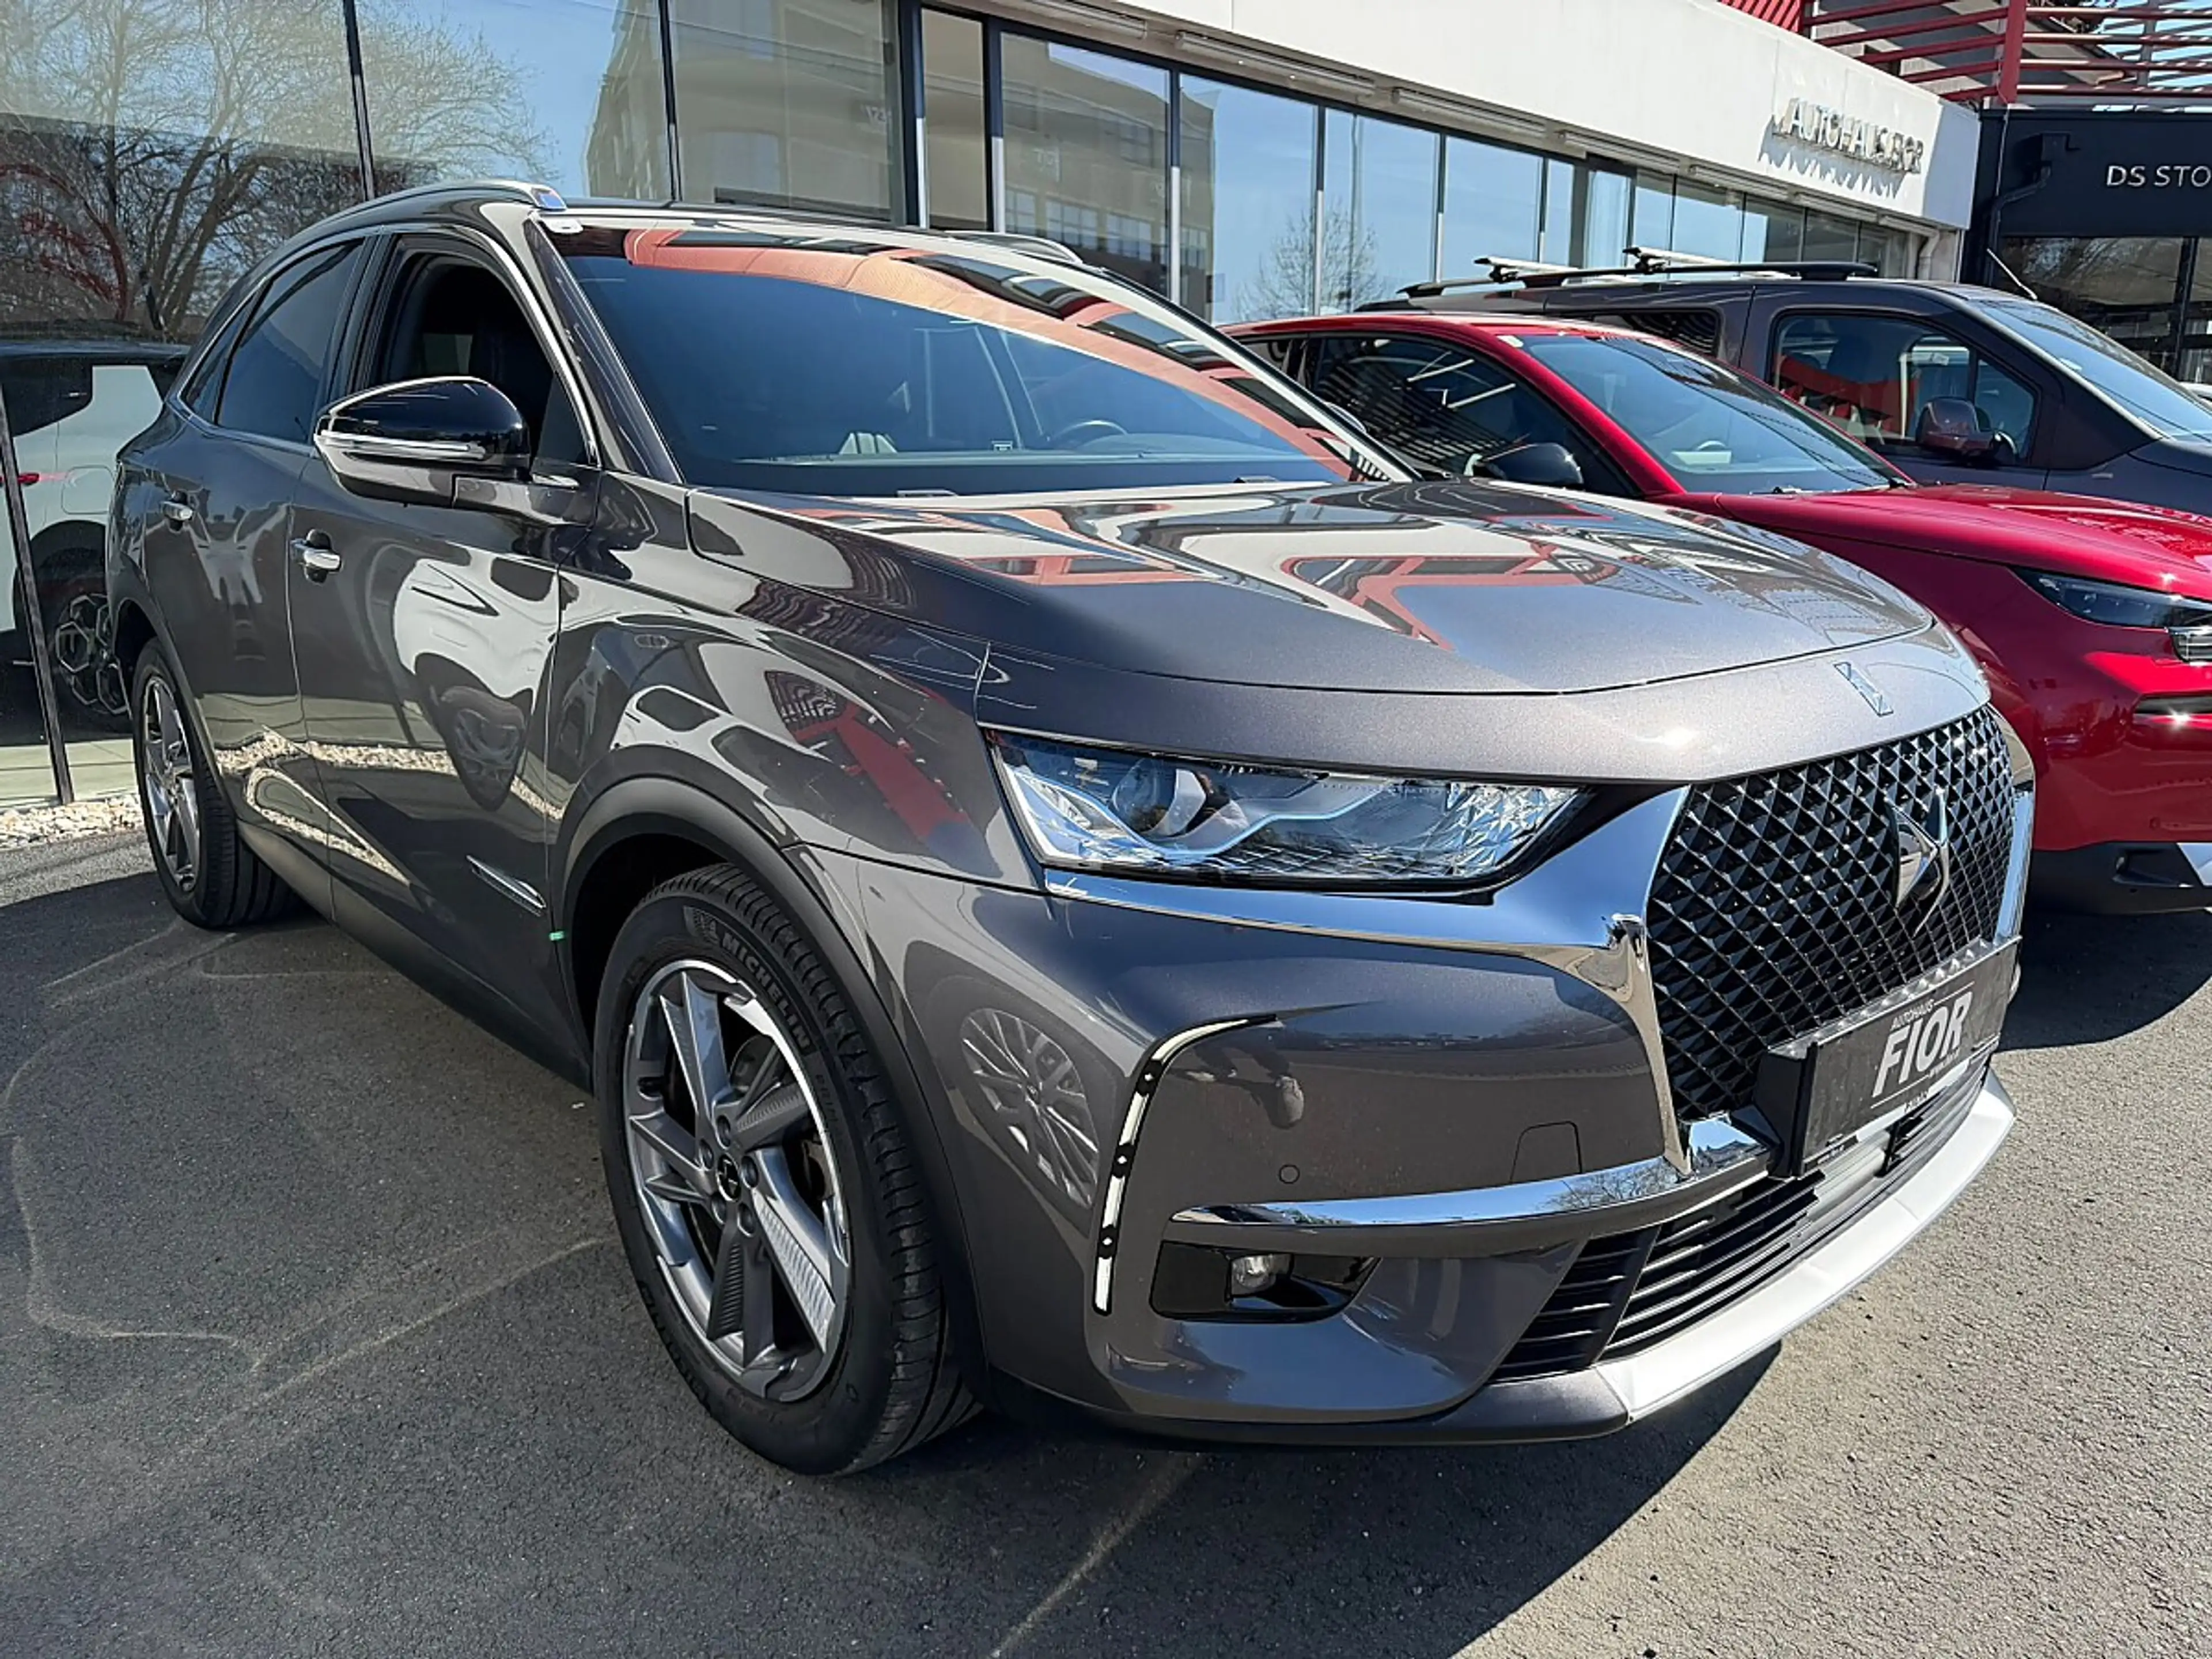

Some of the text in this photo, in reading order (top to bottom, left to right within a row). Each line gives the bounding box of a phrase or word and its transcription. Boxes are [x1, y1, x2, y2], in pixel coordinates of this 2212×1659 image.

[2106, 165, 2211, 187] DS STO
[722, 931, 810, 1050] MICHELIN
[1872, 991, 1974, 1098] FIOR
